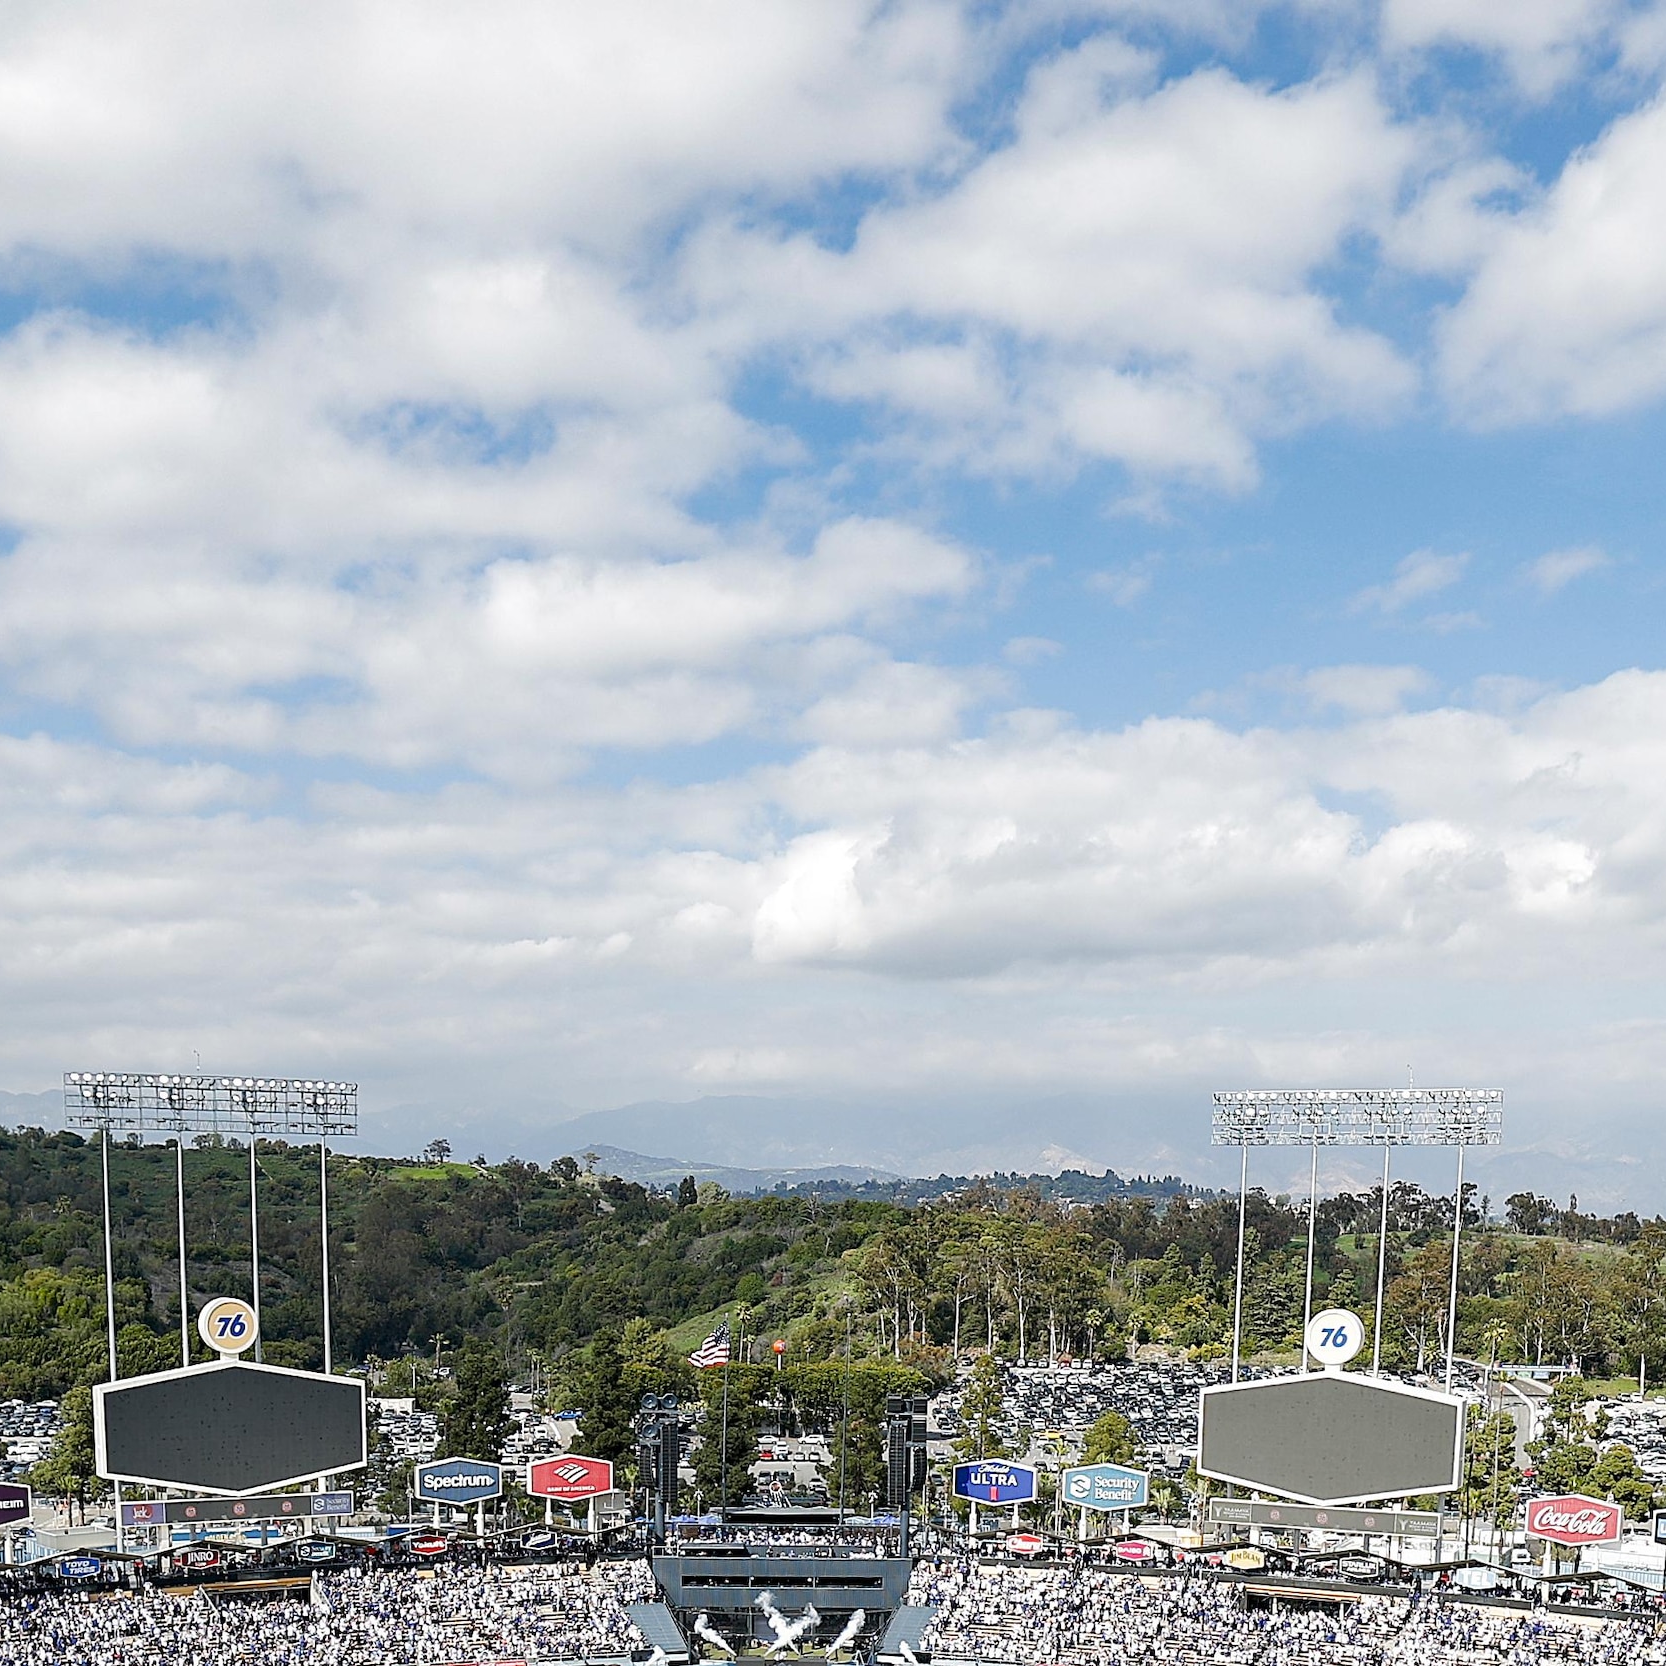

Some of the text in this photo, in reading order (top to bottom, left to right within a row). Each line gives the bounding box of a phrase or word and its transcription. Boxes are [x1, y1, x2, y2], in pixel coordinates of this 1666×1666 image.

[214, 1313, 248, 1340] 76
[1320, 1327, 1348, 1348] 76
[423, 1472, 489, 1491] Spectrum
[970, 1472, 1018, 1486] ULTRA
[1094, 1475, 1139, 1492] Security
[1094, 1488, 1134, 1501] Benefit
[1533, 1505, 1612, 1537] Coca-Cola
[65, 1561, 90, 1569] TOYO
[187, 1551, 214, 1566] JINRO
[1462, 1571, 1490, 1586] TEL
